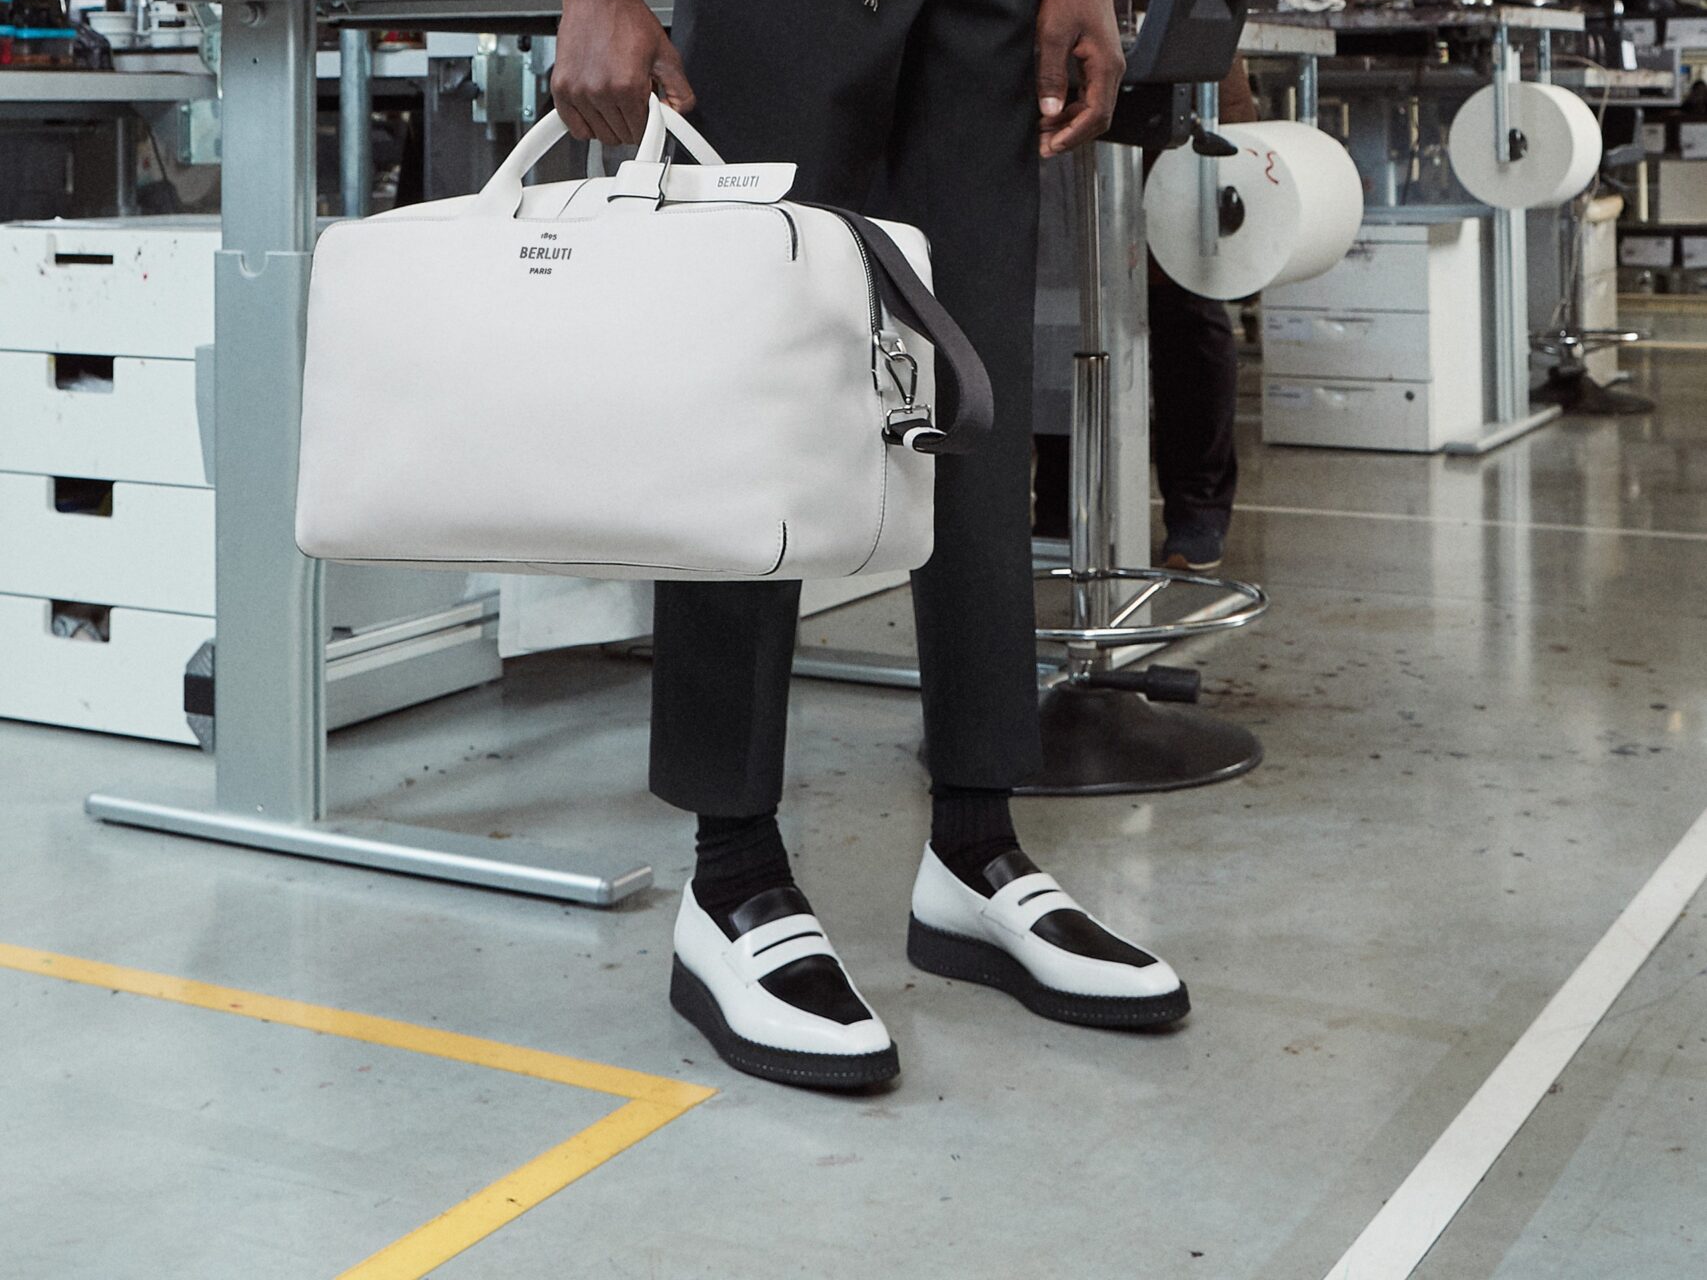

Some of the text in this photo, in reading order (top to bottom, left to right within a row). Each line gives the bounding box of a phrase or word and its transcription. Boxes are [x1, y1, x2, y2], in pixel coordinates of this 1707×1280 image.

[717, 175, 760, 188] BERLUTI
[541, 232, 557, 241] 1895
[519, 246, 572, 260] BERLUTI
[529, 267, 552, 275] PARIS
